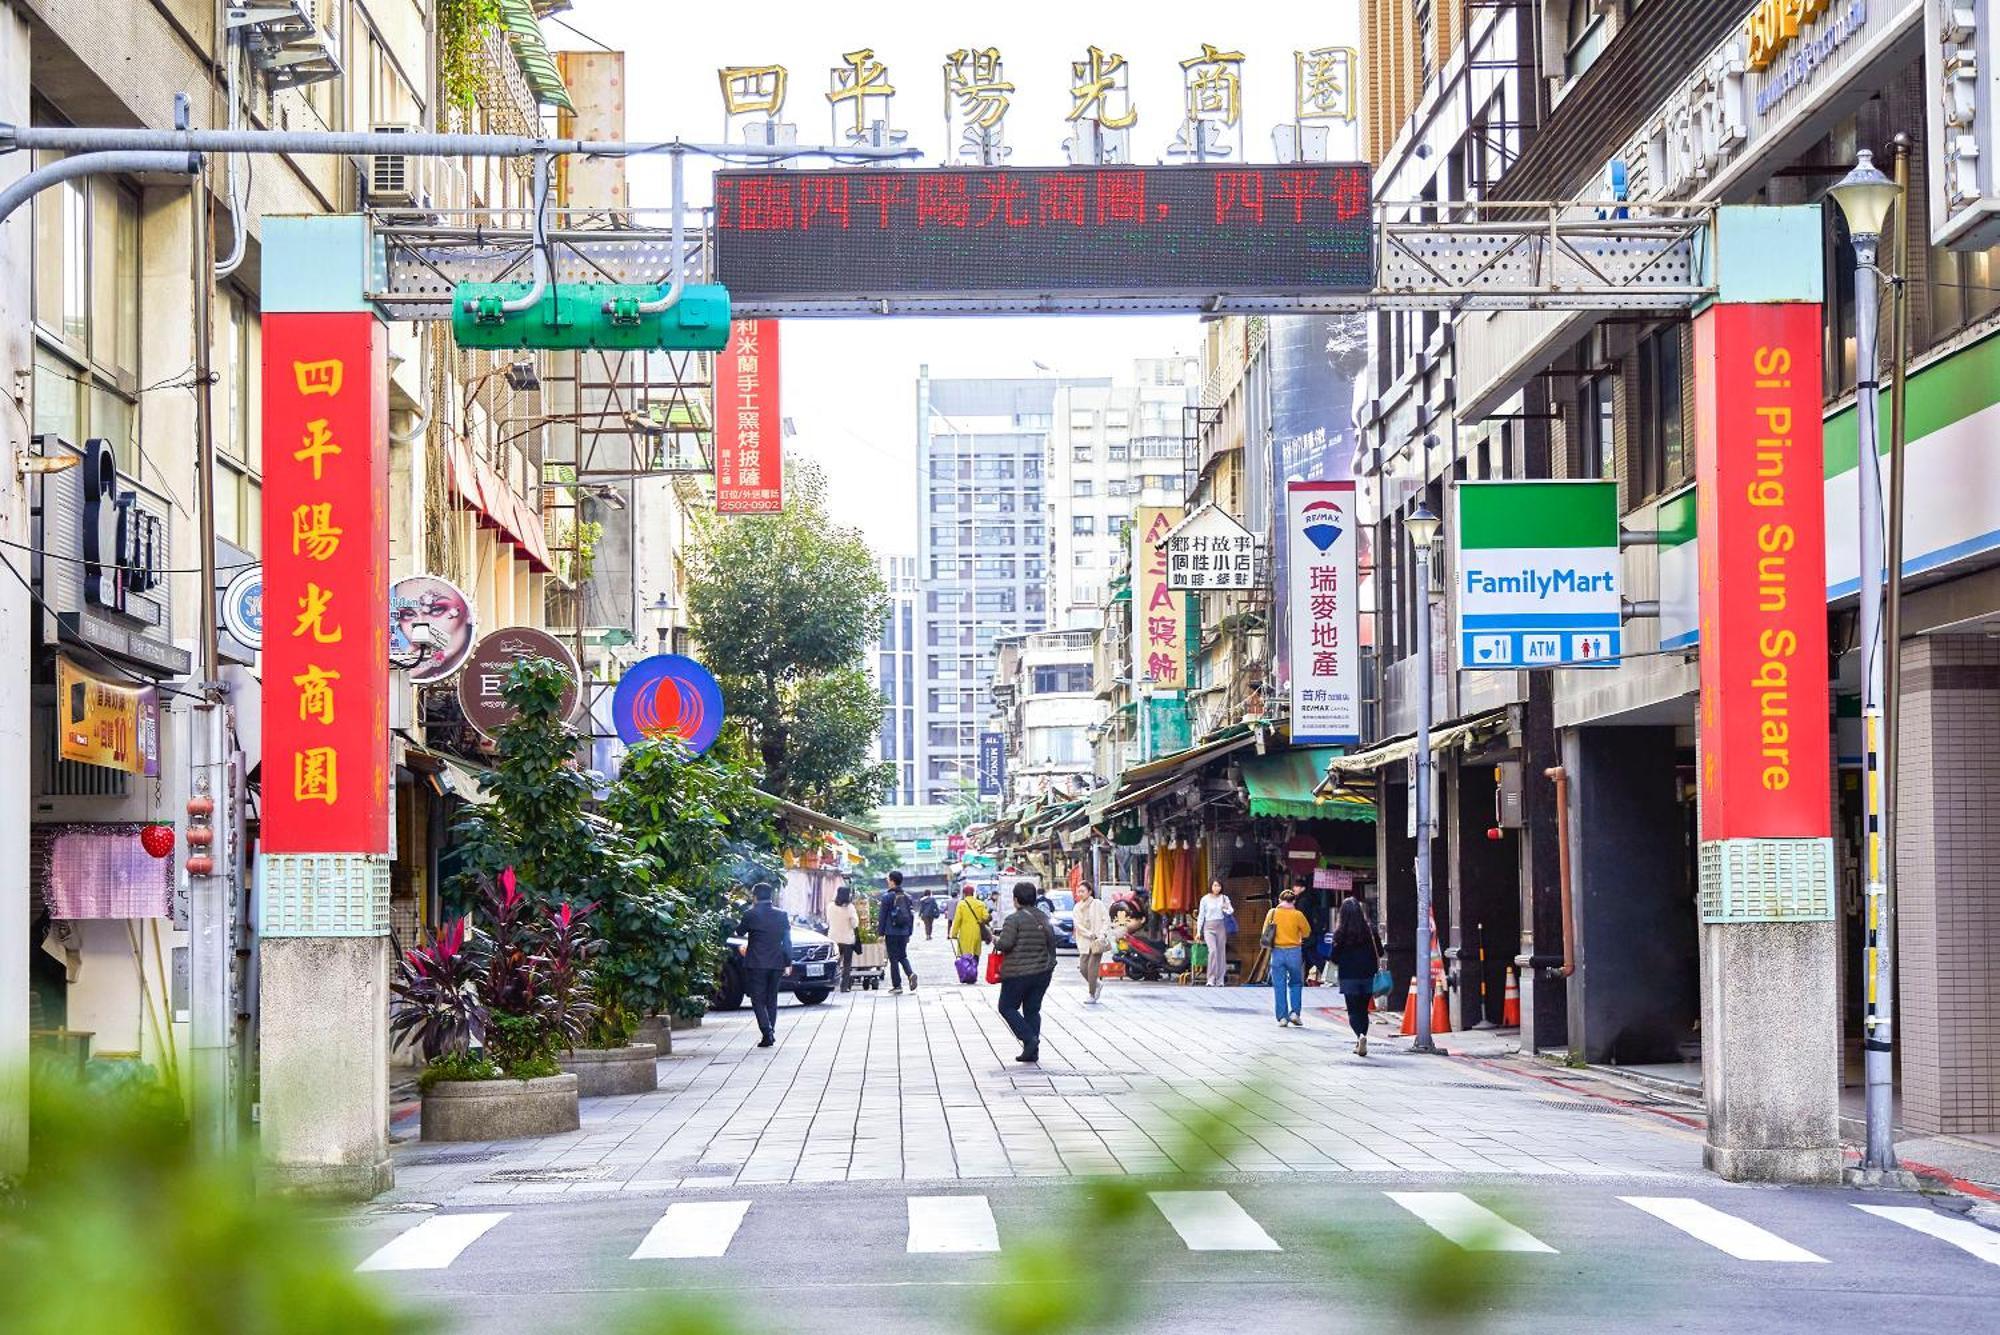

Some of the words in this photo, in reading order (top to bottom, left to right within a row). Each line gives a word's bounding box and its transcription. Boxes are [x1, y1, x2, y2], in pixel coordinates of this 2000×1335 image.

[718, 44, 1357, 133] 四平陽光商圈
[1753, 347, 1792, 388] Si
[1748, 405, 1793, 506] Ping
[1305, 512, 1340, 523] RE/MAX
[1171, 536, 1252, 553] 鄉村故事
[1172, 554, 1250, 571] 個性小店
[292, 360, 343, 804] 四平陽光商圈
[1467, 568, 1614, 599] FamilyMart
[1756, 524, 1795, 611] Sun
[1310, 565, 1339, 677] 瑞麥地產
[1529, 640, 1555, 657] ATM
[1301, 689, 1327, 702] 首府
[1751, 629, 1796, 791] Square
